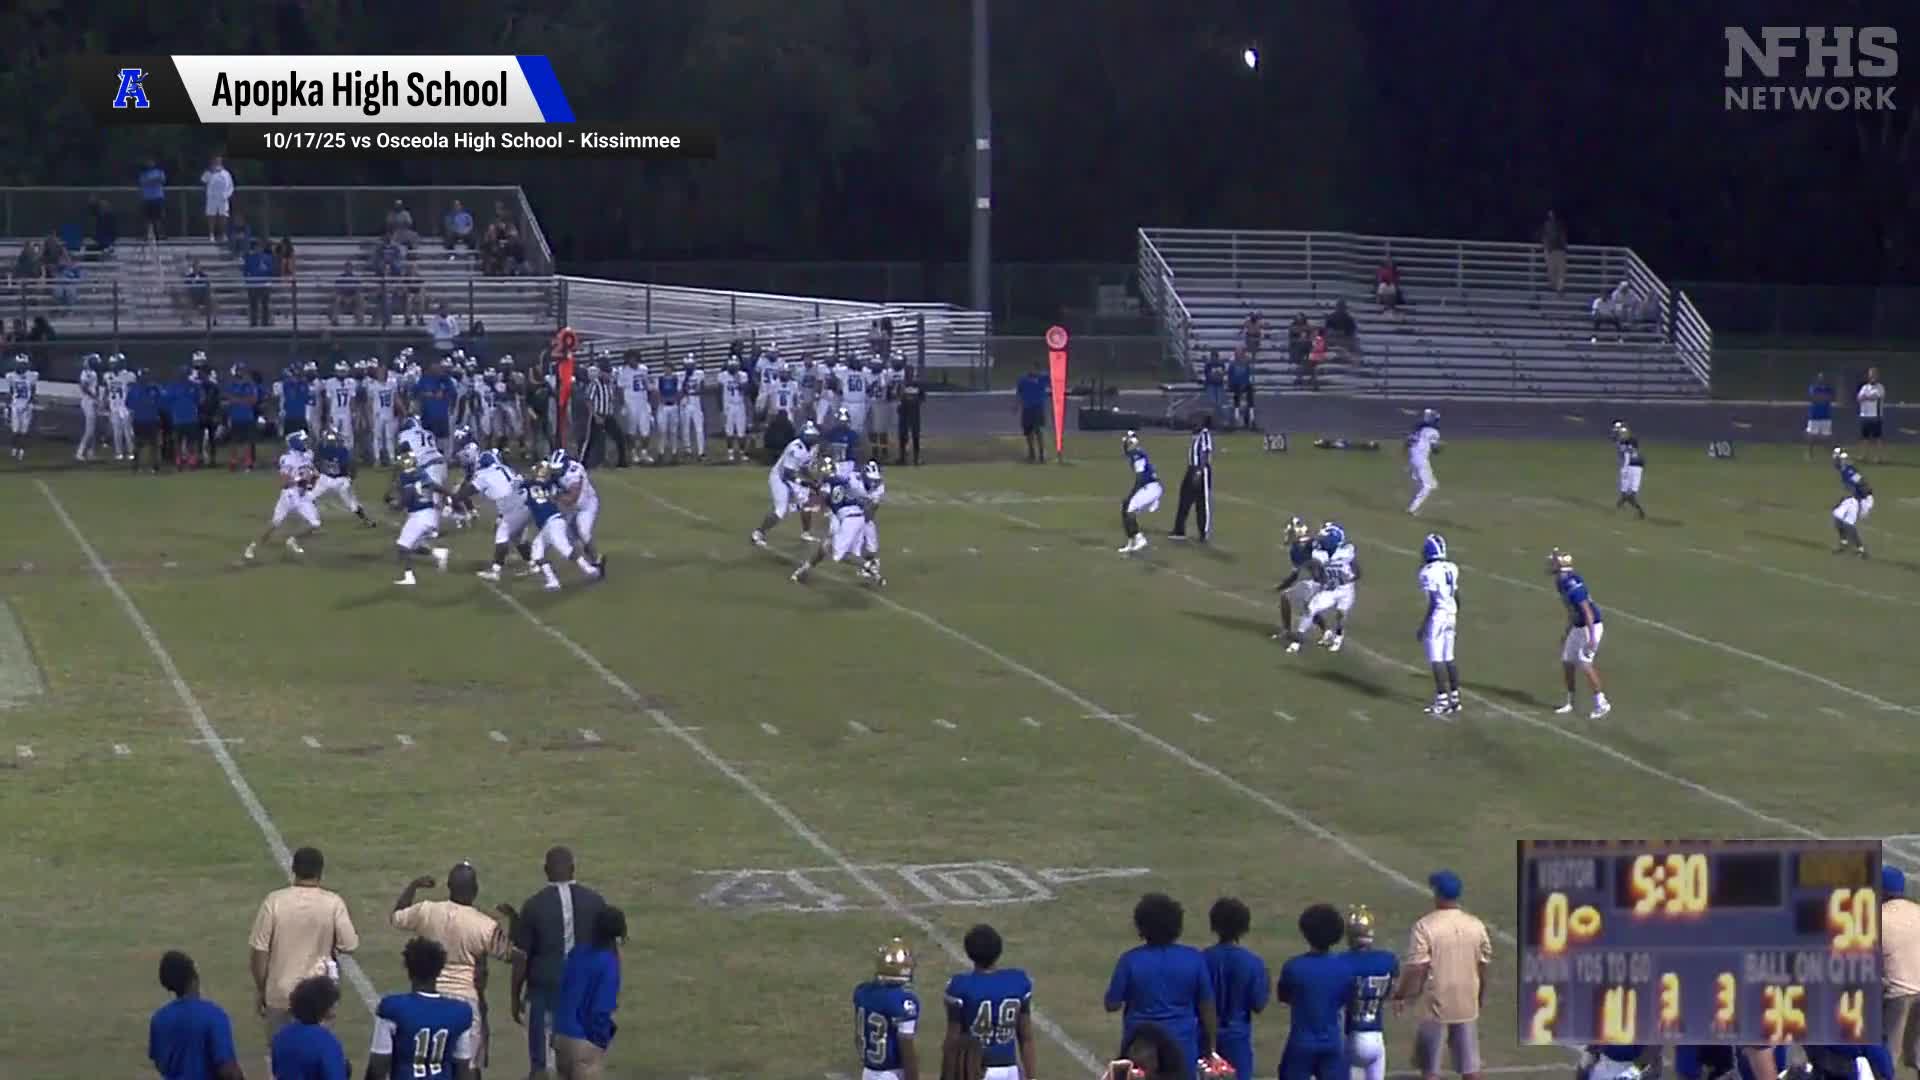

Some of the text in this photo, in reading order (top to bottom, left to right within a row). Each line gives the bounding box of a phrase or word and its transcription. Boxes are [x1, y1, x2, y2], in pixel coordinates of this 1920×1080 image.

[1445, 571, 1454, 597] 4
[1632, 853, 1709, 915] 5:30
[1829, 887, 1877, 951] 50
[1607, 953, 1627, 983] TO
[1744, 953, 1790, 983] BALL
[1794, 953, 1824, 983] ON
[1828, 953, 1877, 983] QTR
[855, 1008, 888, 1065] 13
[1531, 985, 1558, 1045] 2
[1837, 989, 1864, 1038] 4
[412, 1027, 449, 1078] 11
